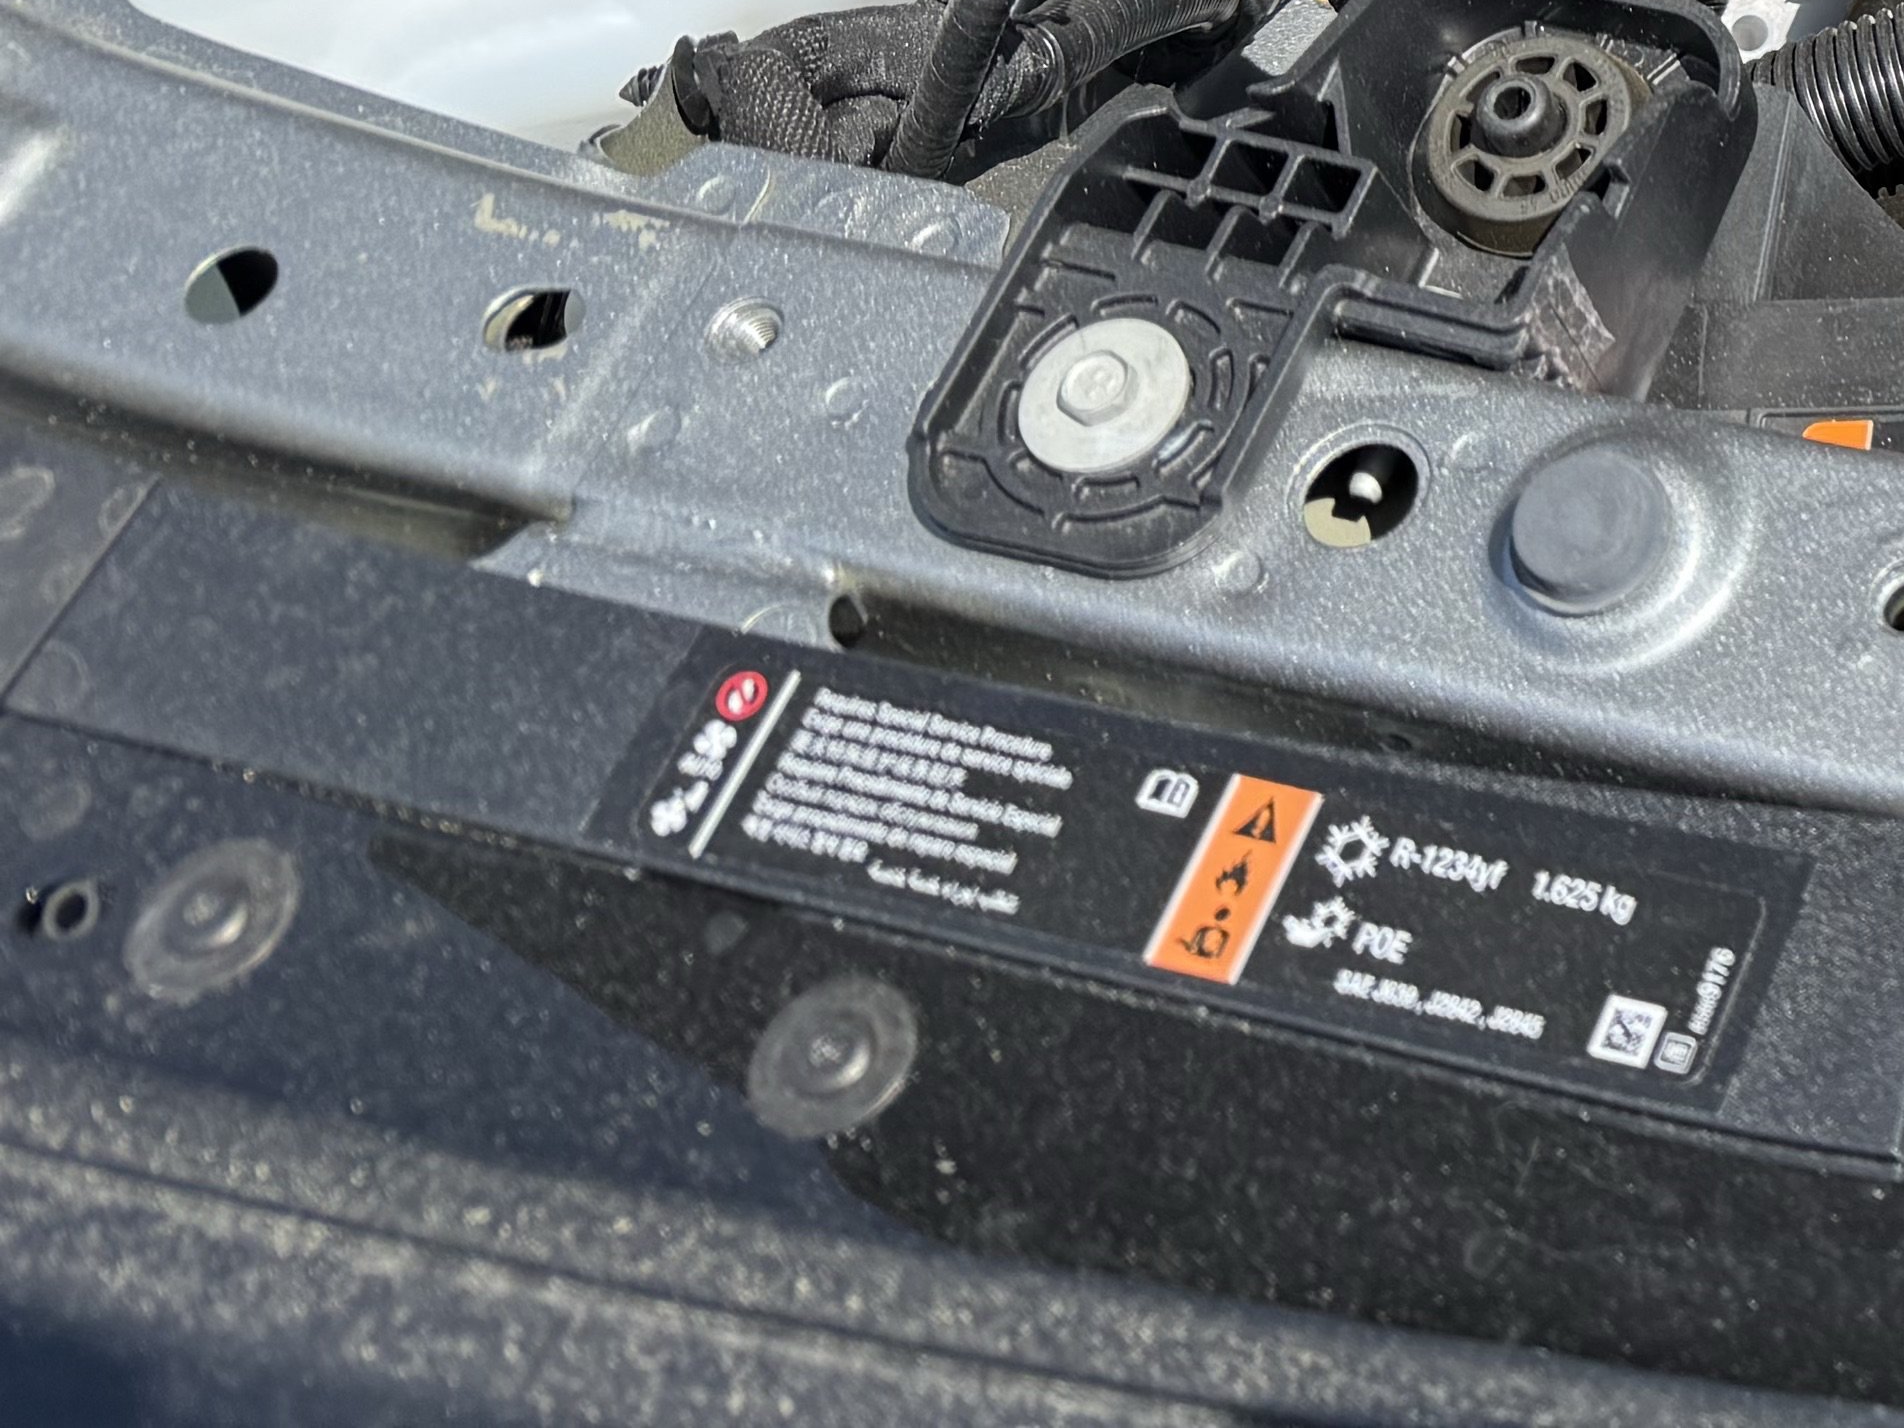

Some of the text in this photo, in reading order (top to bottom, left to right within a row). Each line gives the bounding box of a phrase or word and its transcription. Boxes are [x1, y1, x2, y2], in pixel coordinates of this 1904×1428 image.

[1386, 838, 1510, 895] R-1234yf
[1530, 870, 1604, 912] 1.625
[1349, 920, 1415, 964] POE
[1330, 967, 1377, 1000] SAE
